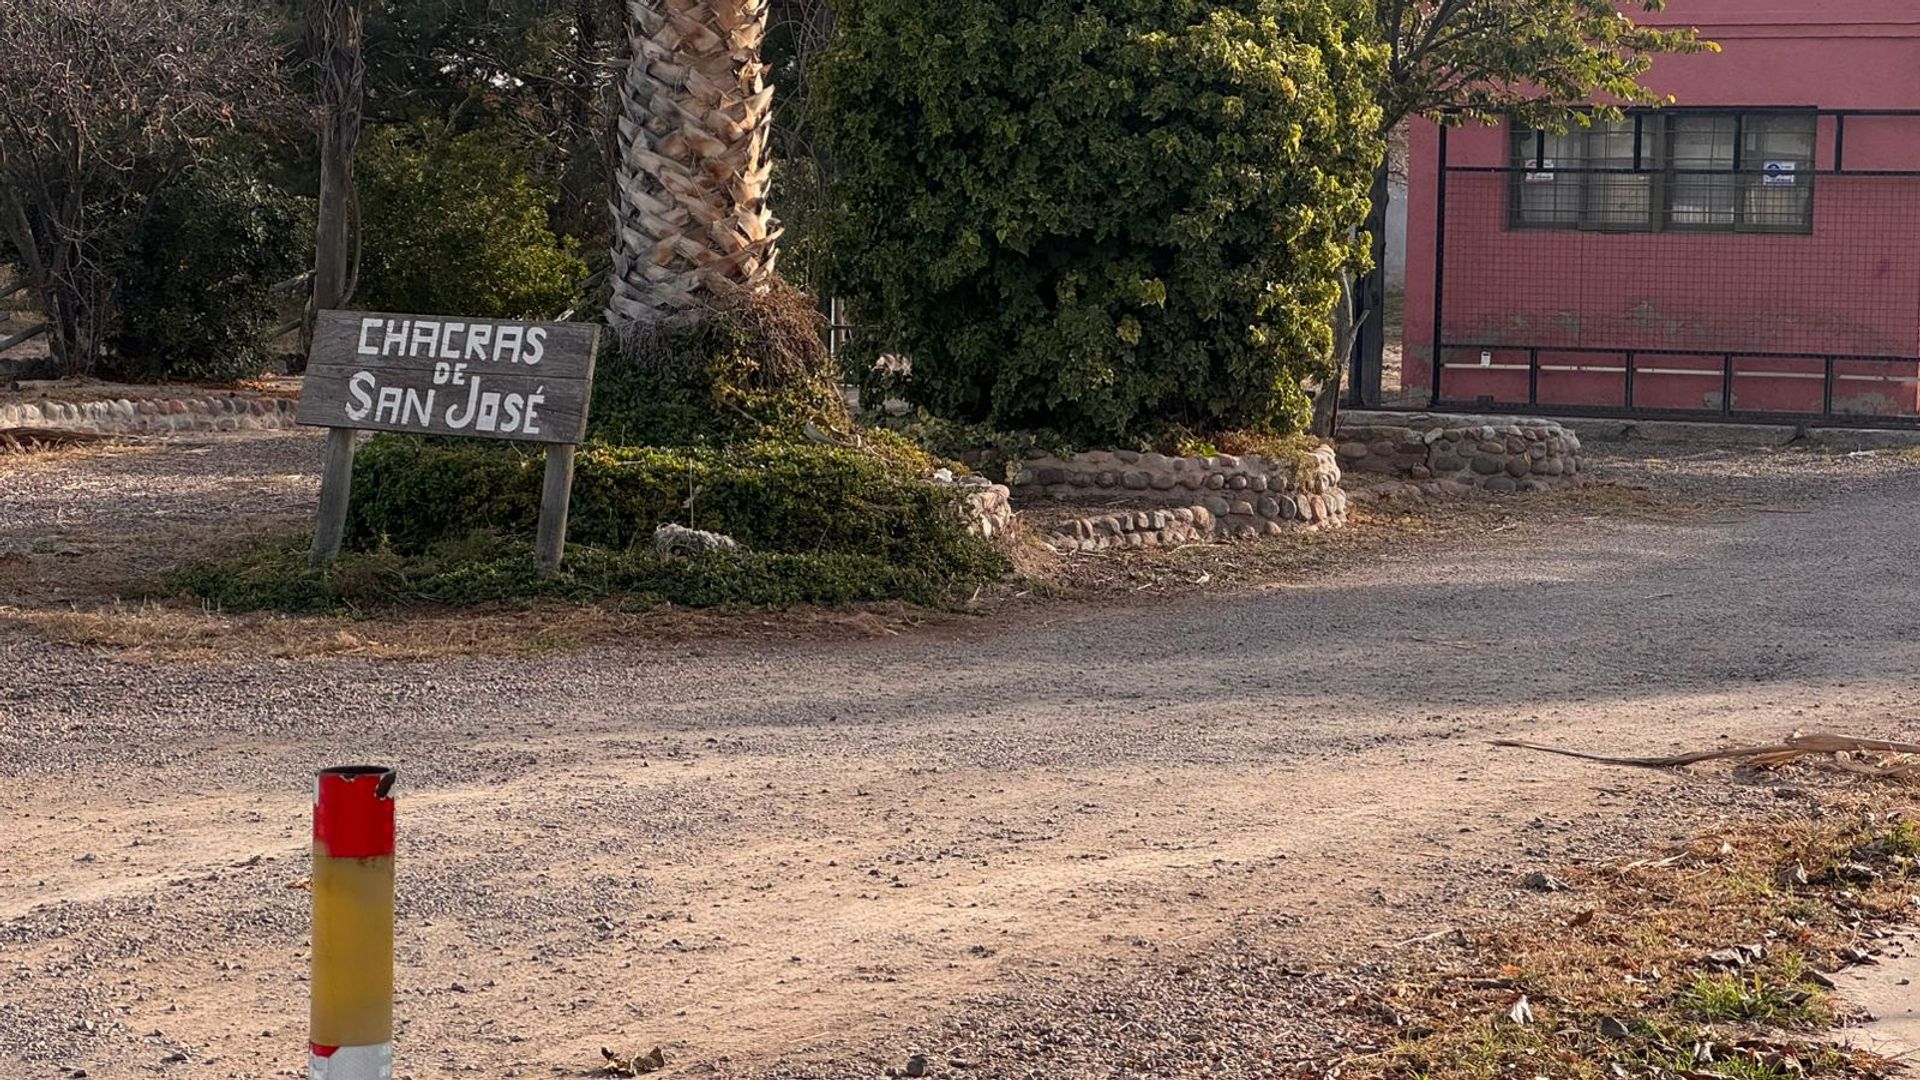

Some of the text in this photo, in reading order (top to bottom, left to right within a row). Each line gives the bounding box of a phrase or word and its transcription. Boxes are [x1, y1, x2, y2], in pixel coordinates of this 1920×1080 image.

[357, 317, 547, 365] CHACRAS
[433, 362, 468, 385] DE
[345, 370, 545, 434] SAN JOSÉ
